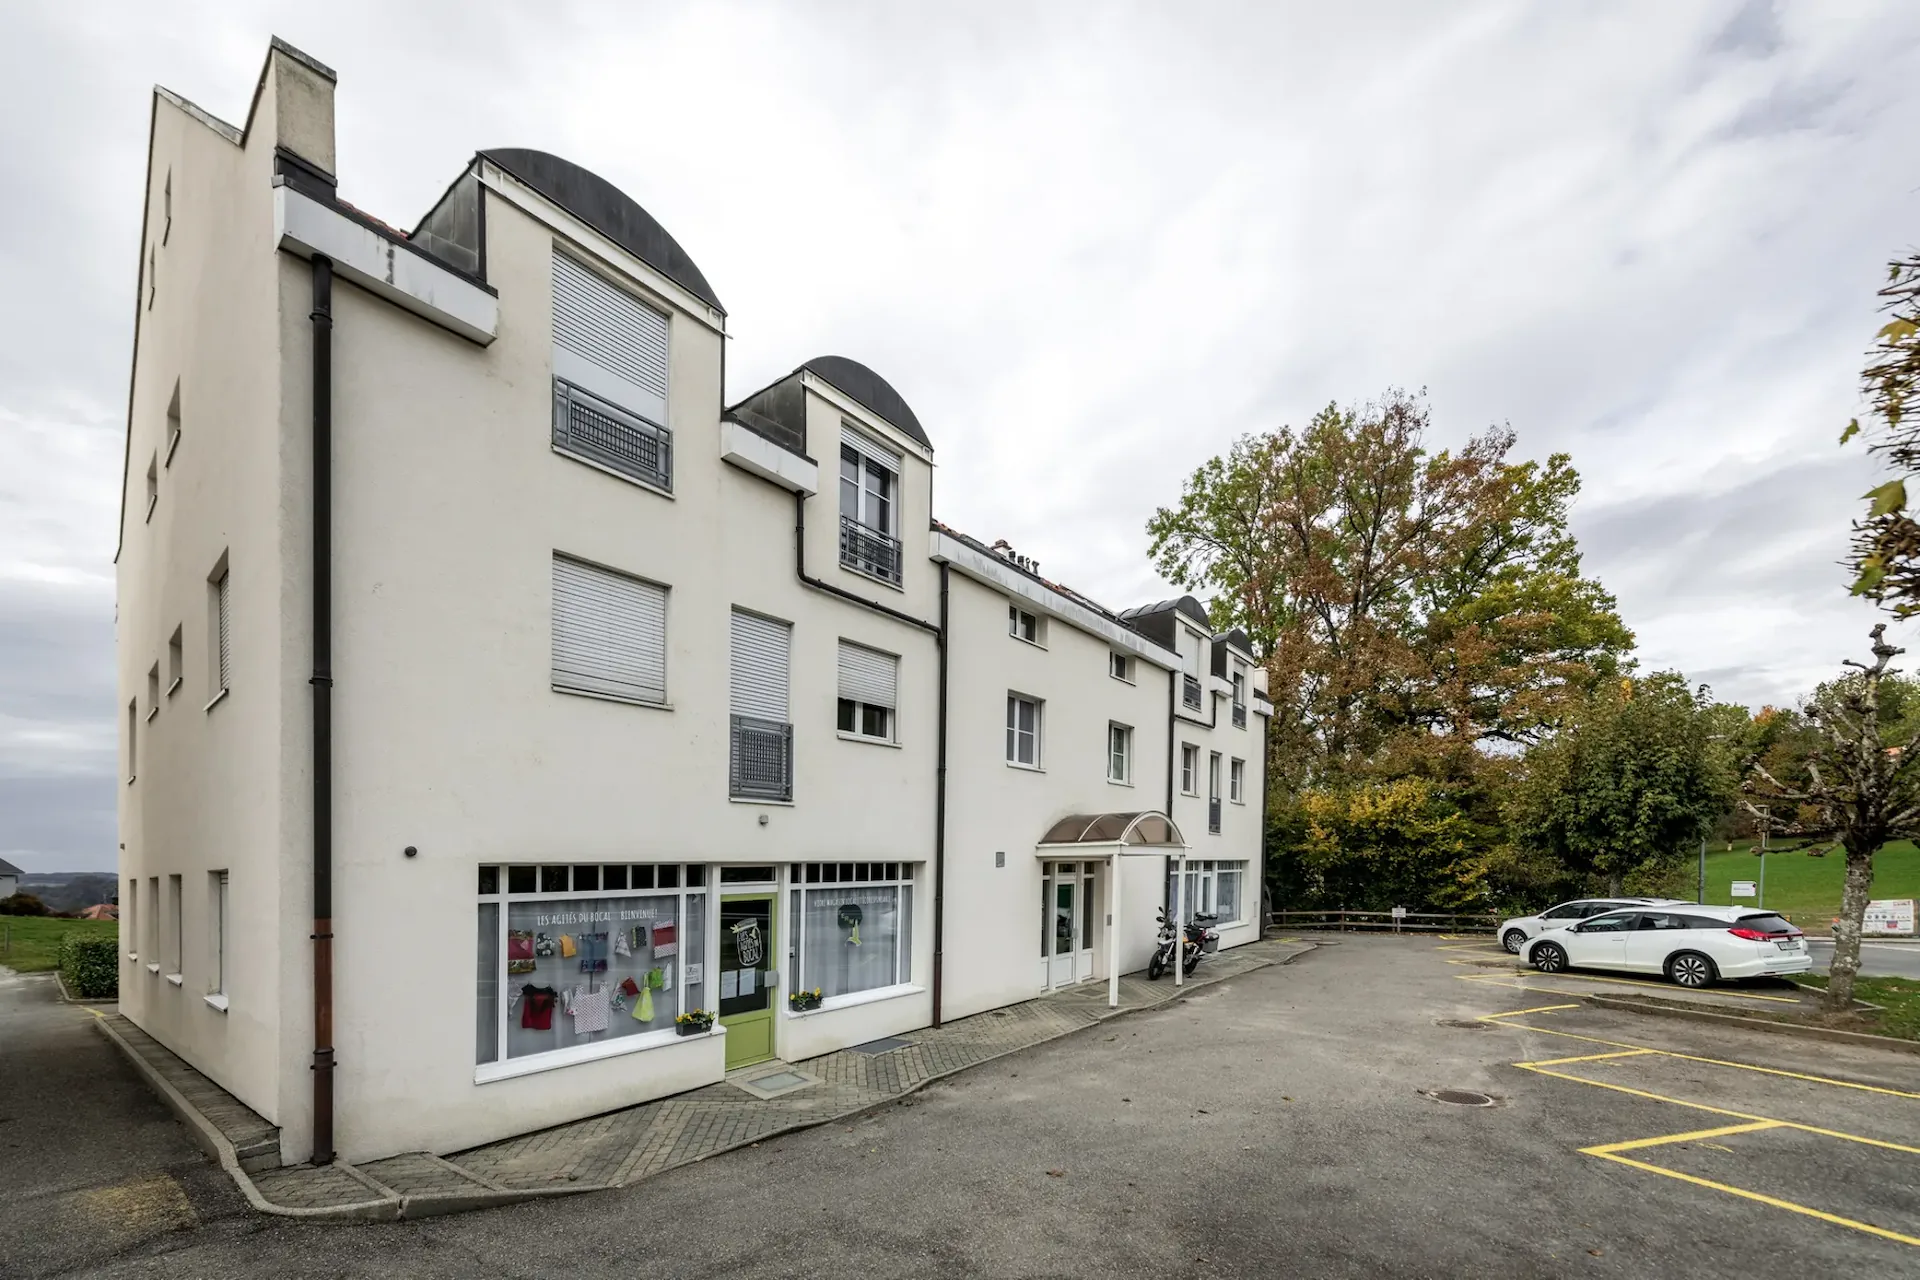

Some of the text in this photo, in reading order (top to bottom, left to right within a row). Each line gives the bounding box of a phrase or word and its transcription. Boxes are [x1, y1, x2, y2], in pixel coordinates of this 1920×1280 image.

[537, 915, 550, 926] LES
[551, 912, 577, 925] AGITÉS
[578, 912, 589, 923] DU
[590, 911, 611, 922] BOCAL
